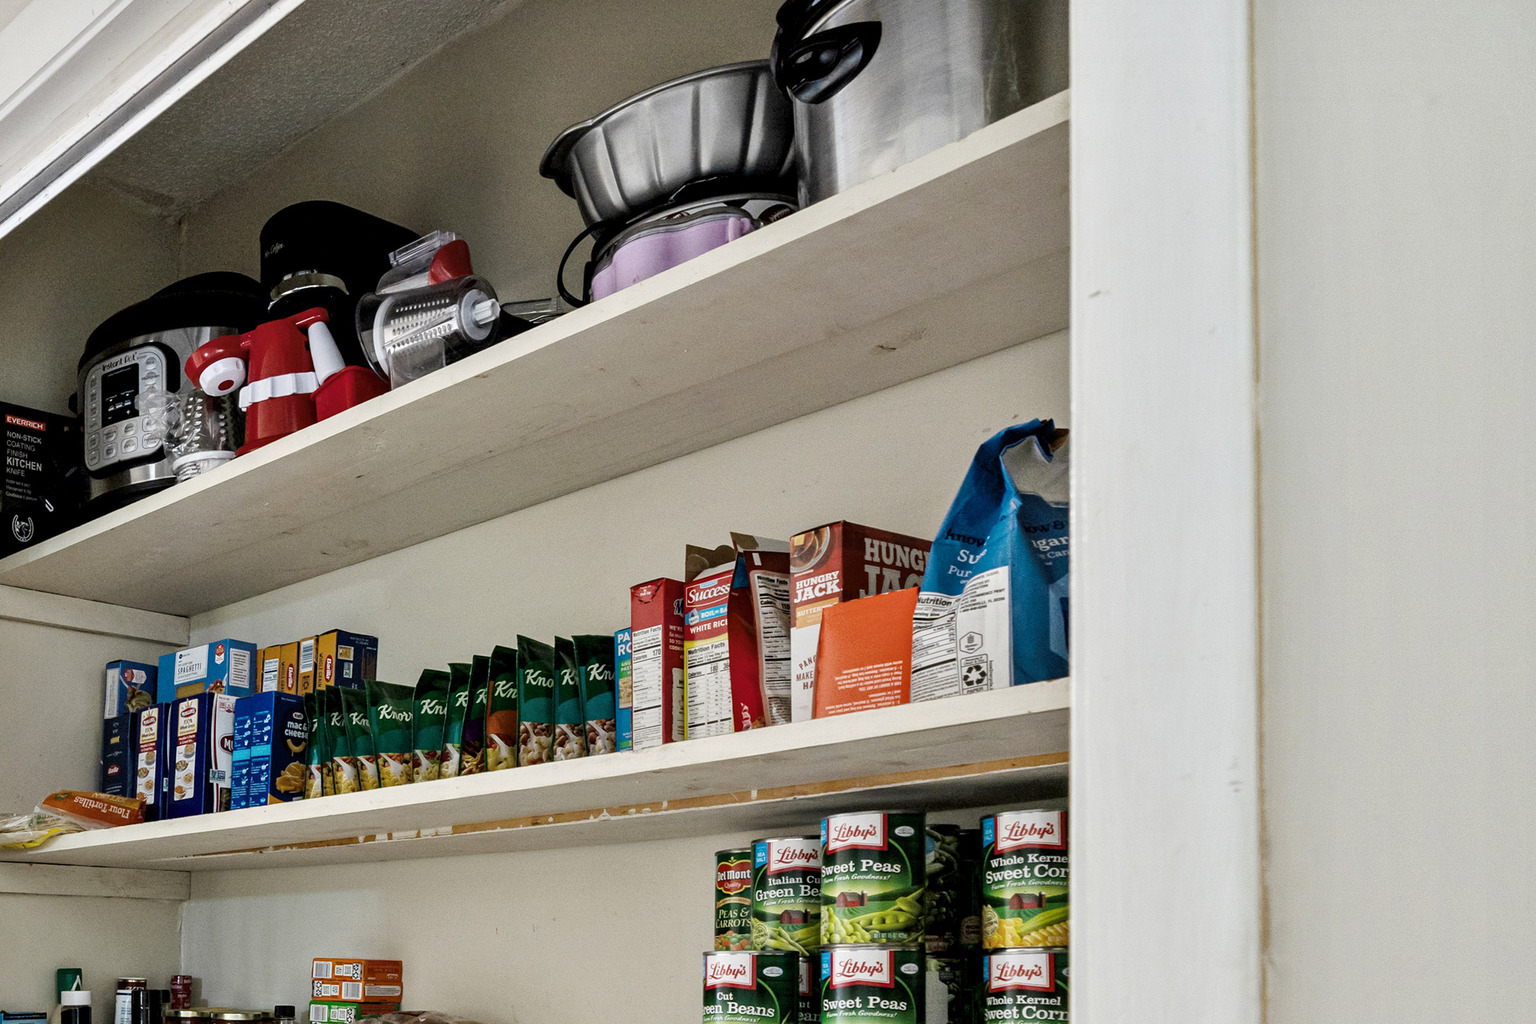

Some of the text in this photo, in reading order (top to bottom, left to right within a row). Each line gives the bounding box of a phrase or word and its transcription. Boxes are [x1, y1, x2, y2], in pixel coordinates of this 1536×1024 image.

[102, 352, 137, 371] Instant Pot
[7, 417, 44, 430] EVERRICH
[6, 431, 42, 444] NON-STICK
[6, 440, 36, 452] COATING
[7, 449, 28, 459] FINISH
[6, 457, 42, 471] KITCHEN
[6, 468, 25, 477] KNIFE
[796, 571, 839, 589] HUNGRY
[687, 583, 730, 605] Success
[690, 624, 712, 634] WHITE
[688, 645, 709, 655] Nutrition
[711, 642, 726, 651] Facts
[178, 663, 201, 675] SPAGHETTI
[287, 721, 302, 729] mac
[74, 796, 131, 819] Flour Tortillas
[832, 823, 877, 842] Libby's
[1001, 821, 1054, 842] Libby's
[774, 846, 819, 864] Libby's
[991, 855, 1024, 869] Whole
[822, 860, 901, 877] Sweet Peas
[986, 865, 1031, 884] Sweet
[768, 875, 802, 886] Italian
[1007, 880, 1027, 888] Fresh
[756, 885, 794, 901] Green
[718, 907, 750, 918] PEAS &
[708, 960, 747, 979] Libby's
[836, 959, 884, 978] Libby's
[993, 961, 1043, 981] Libby's
[717, 992, 733, 1001] Cut
[823, 996, 907, 1011] Sweet Peas
[986, 995, 1061, 1006] Whole Kernel
[727, 1002, 775, 1017] Beans
[858, 1010, 897, 1018] Goodness!
[724, 1014, 761, 1023] Goodness!
